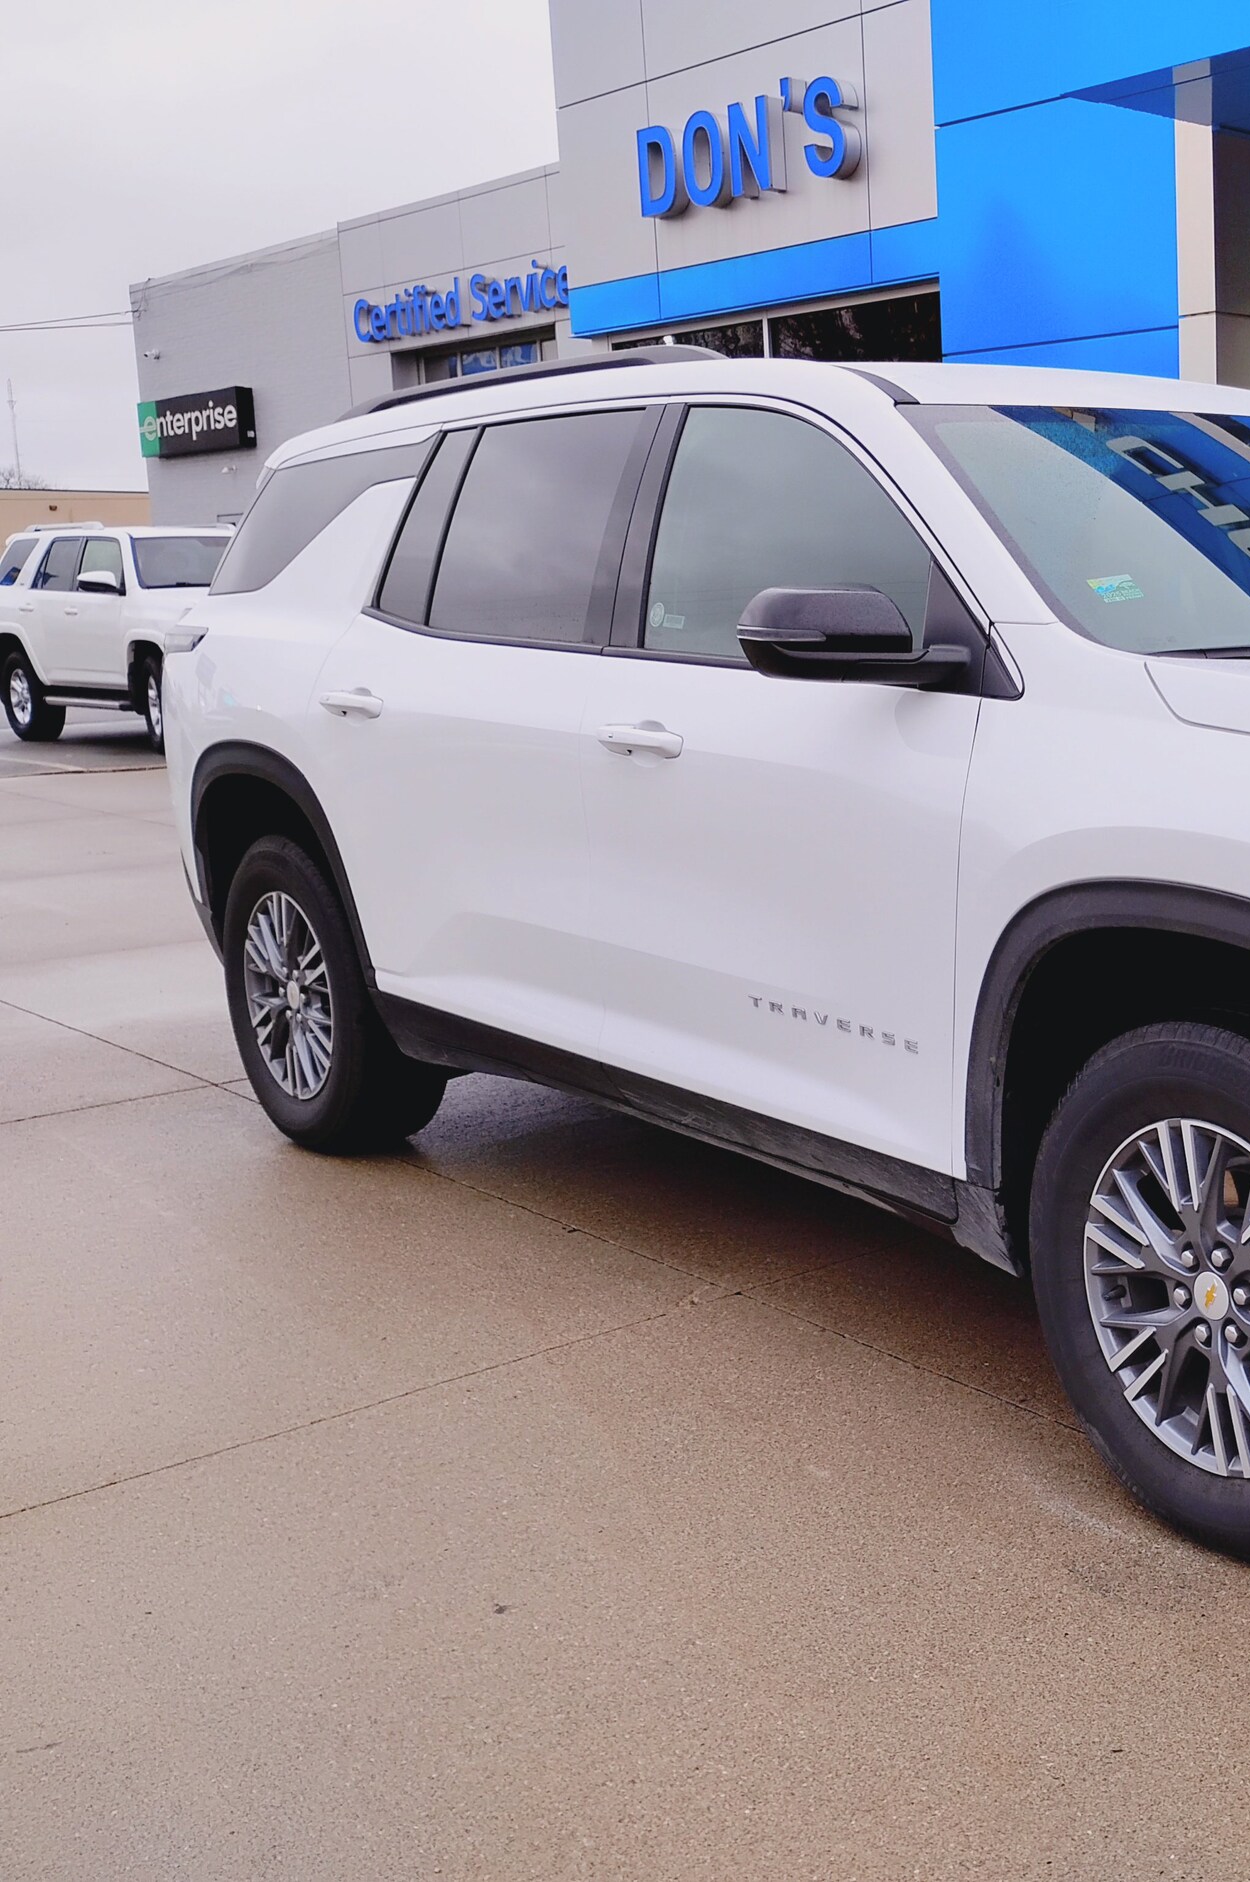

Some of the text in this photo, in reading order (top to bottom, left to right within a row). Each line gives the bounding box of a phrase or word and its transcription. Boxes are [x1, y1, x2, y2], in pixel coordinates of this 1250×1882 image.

[636, 76, 856, 217] DON'S
[354, 259, 569, 343] Certified Service
[141, 400, 238, 441] enterprise
[748, 995, 918, 1055] TRAVERSE
